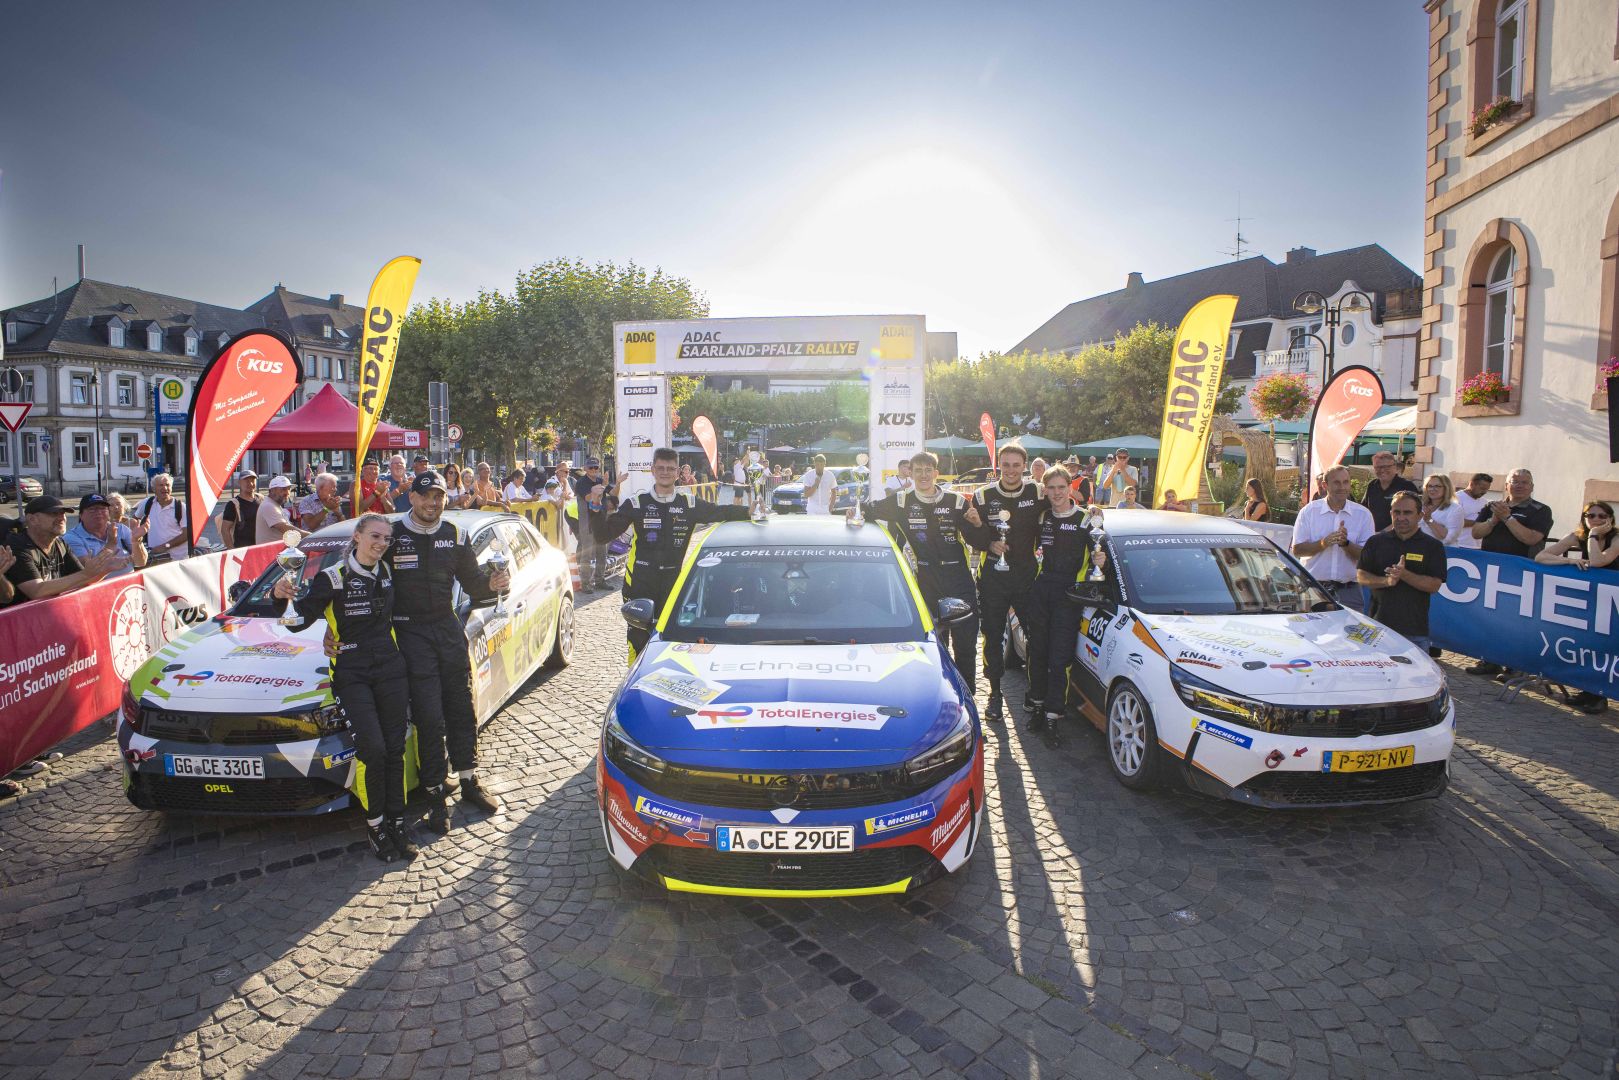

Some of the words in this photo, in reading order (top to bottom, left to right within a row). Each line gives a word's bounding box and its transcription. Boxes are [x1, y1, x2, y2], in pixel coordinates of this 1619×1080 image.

[625, 332, 655, 343] ADAC
[683, 331, 721, 342] ADAC
[681, 343, 803, 357] SAARLAND-PFALZ
[806, 342, 856, 354] RALLYE
[1213, 343, 1224, 362] e.V.
[247, 358, 283, 374] KÜS
[362, 306, 393, 415] ADAC
[168, 383, 177, 396] H
[1167, 339, 1209, 433] ADAC
[1203, 364, 1219, 410] Saarland
[878, 412, 916, 426] KÜS
[1197, 412, 1210, 441] ADAC
[1018, 500, 1034, 508] ADAC
[1060, 523, 1077, 531] ADAC
[434, 540, 454, 549] ADAC
[1124, 538, 1153, 546] ADAC
[705, 550, 739, 558] ADAC
[865, 550, 891, 558] CUP
[1088, 616, 1109, 640] e05
[474, 634, 488, 664] e08
[0, 642, 66, 683] Sympathie
[709, 660, 872, 674] technagon
[1314, 659, 1399, 669] TotalEnergies
[23, 649, 98, 698] Sachverstand
[214, 673, 304, 688] TotalEnergies
[757, 708, 877, 722] TotalEnergies
[1207, 725, 1246, 744] MICHELIN
[174, 758, 193, 774] GG
[202, 758, 220, 775] CE
[1338, 749, 1408, 770] P-921-NV
[204, 784, 234, 793] OPEL
[609, 799, 648, 842] Milwaukee
[651, 806, 693, 823] MICHELIN
[887, 809, 928, 826] MICHELIN
[732, 830, 744, 849] A
[760, 830, 789, 850] CE
